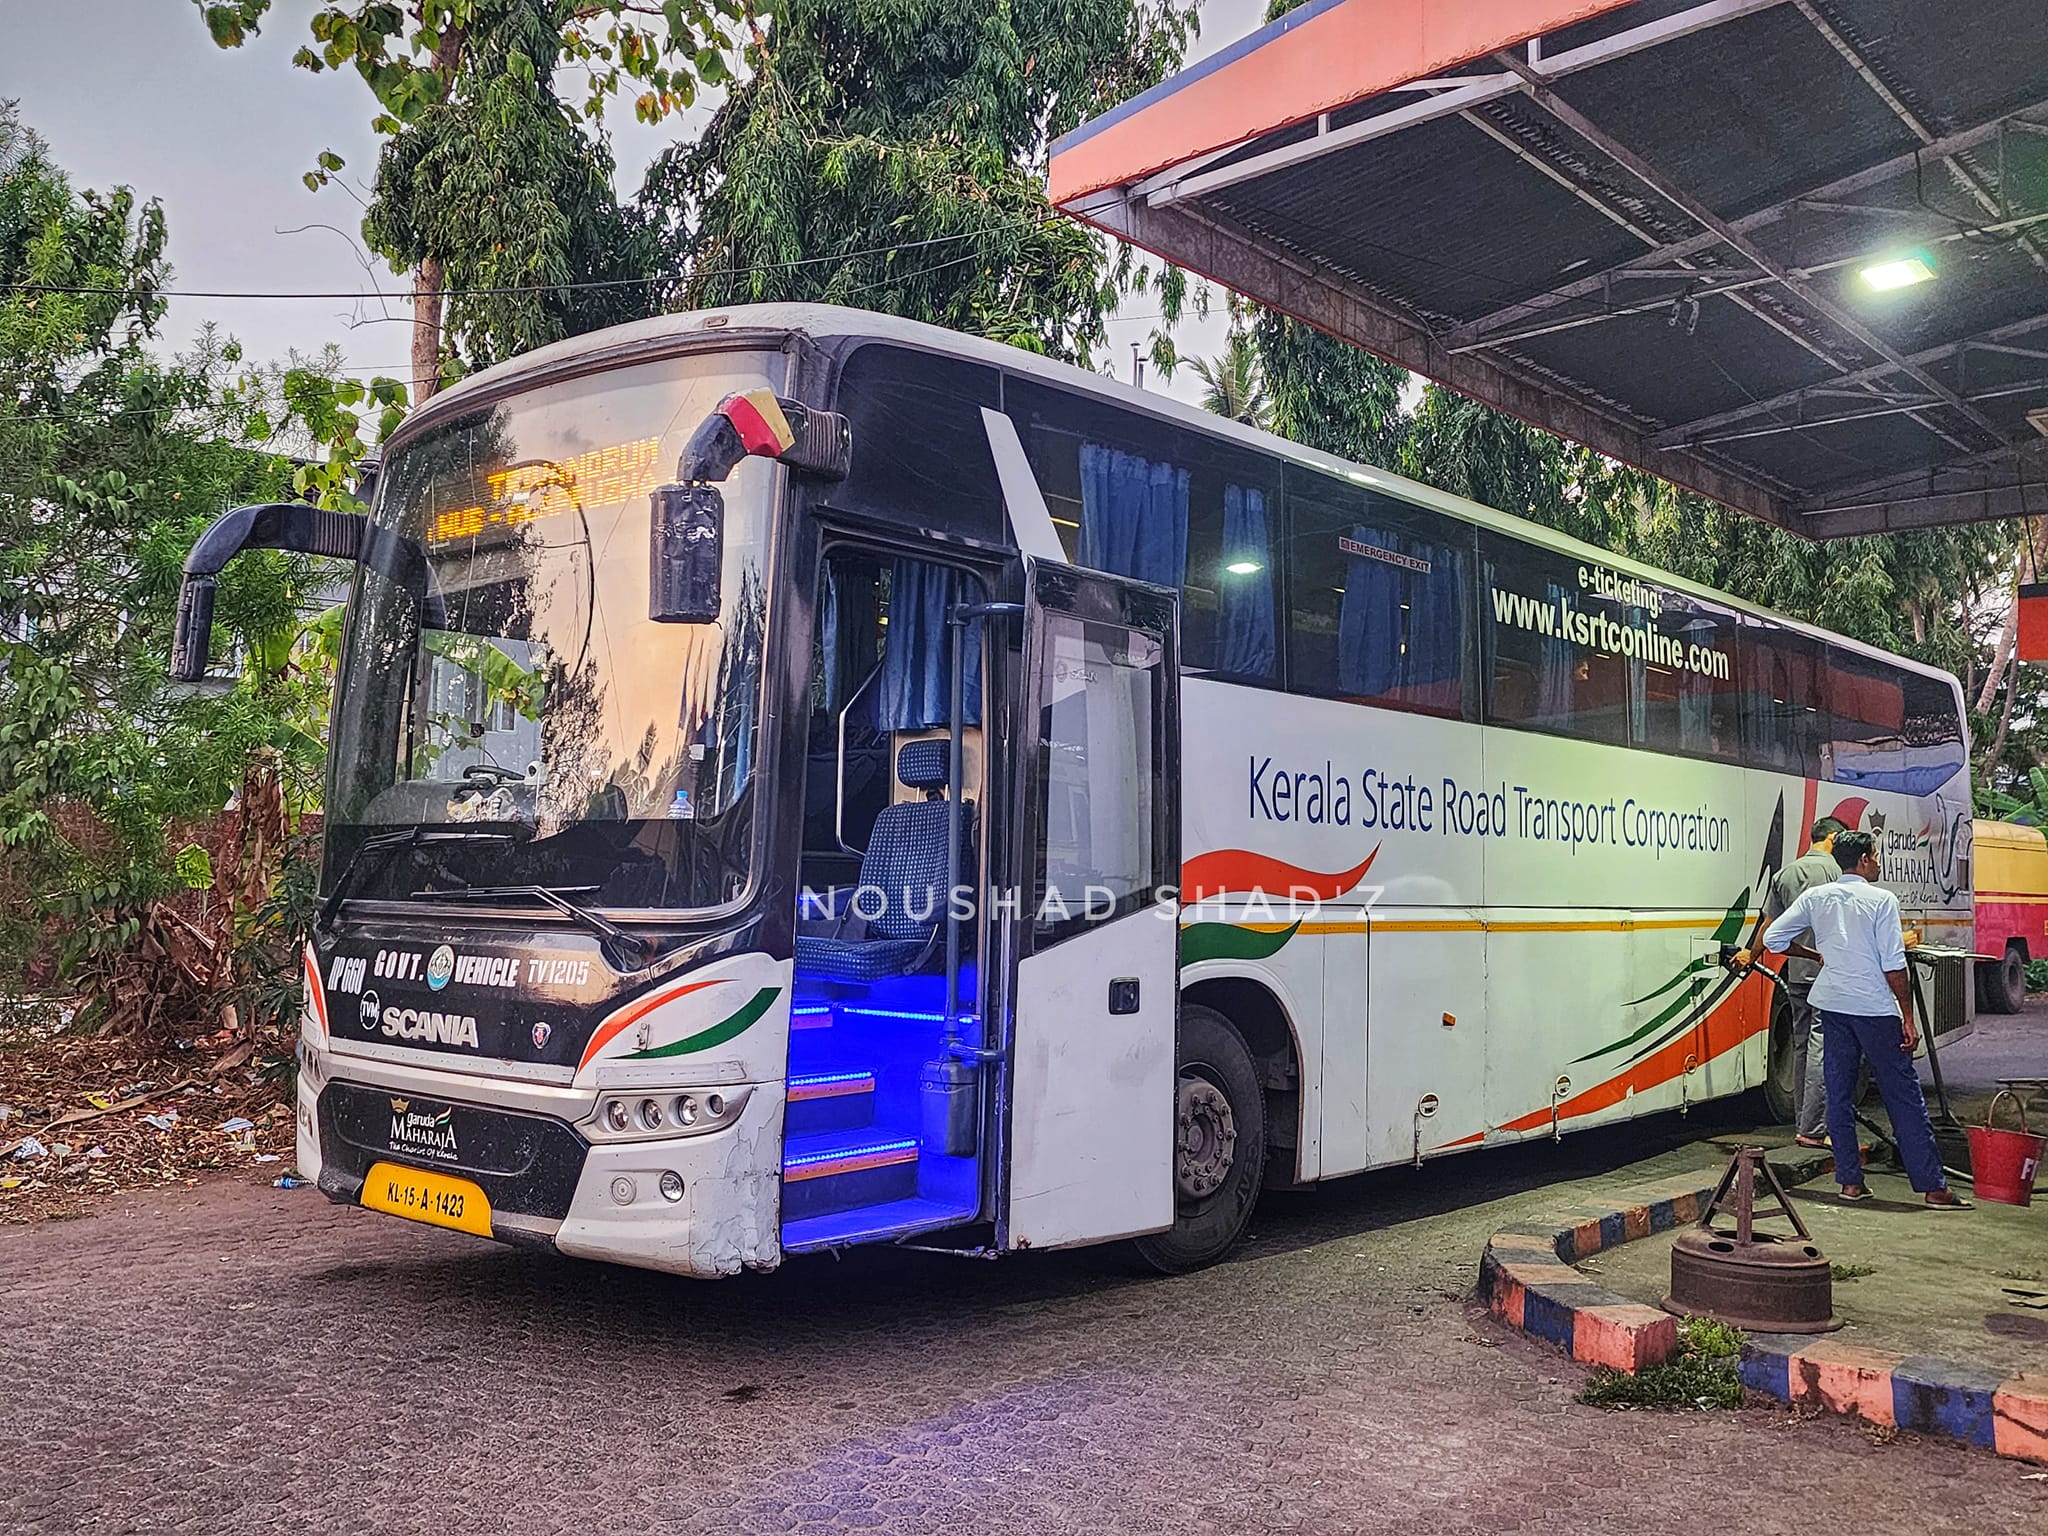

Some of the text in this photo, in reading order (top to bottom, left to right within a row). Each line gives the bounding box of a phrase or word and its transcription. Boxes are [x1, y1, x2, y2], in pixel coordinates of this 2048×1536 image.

[1350, 541, 1429, 572] EMERGENCY EXIT
[1578, 565, 1664, 619] e-ticketing:
[1492, 587, 1729, 681] www.ksrtconline.com
[1248, 755, 1731, 861] Kerala State Road Transport Corporation
[1887, 827, 1917, 856] garuda
[374, 949, 424, 981] GOVT.
[455, 955, 520, 987] VEHICLE
[361, 1000, 379, 1019] TVM
[381, 1006, 479, 1049] SCANIA
[390, 1115, 457, 1150] MAHARAJA
[406, 1112, 435, 1128] garuda
